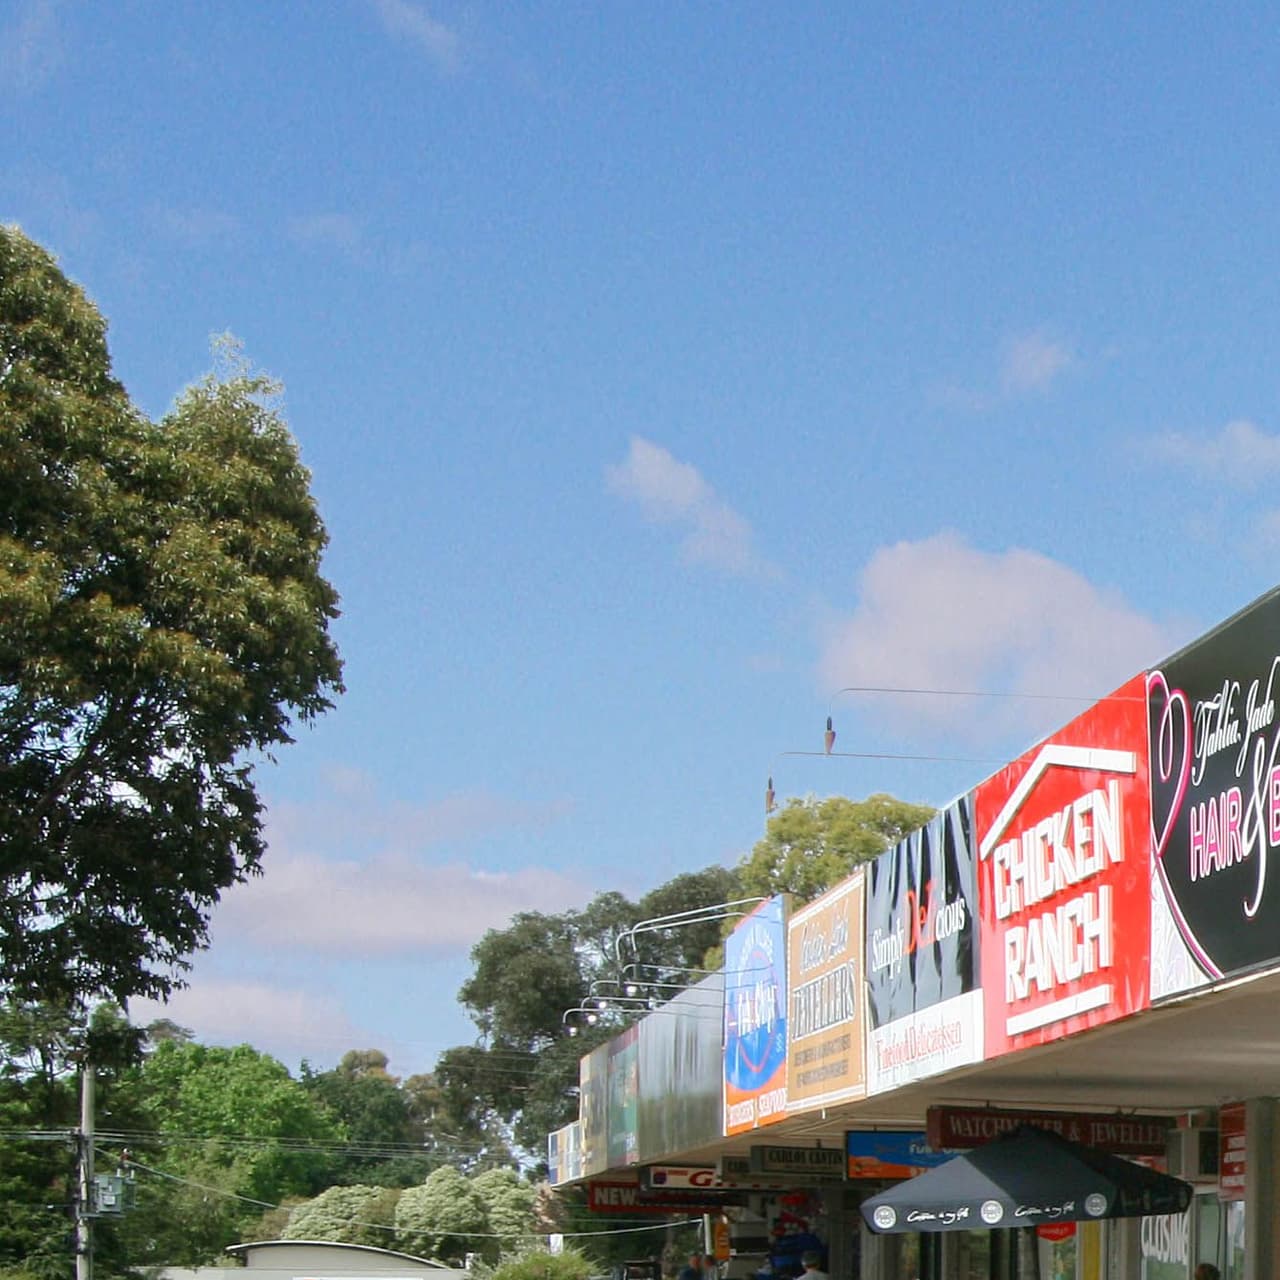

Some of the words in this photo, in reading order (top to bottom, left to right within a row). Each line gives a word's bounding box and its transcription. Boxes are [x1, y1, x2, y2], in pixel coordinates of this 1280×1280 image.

[992, 780, 1125, 920] CHICKEN
[1190, 786, 1243, 881] HAIR
[1005, 885, 1114, 1003] RANCH
